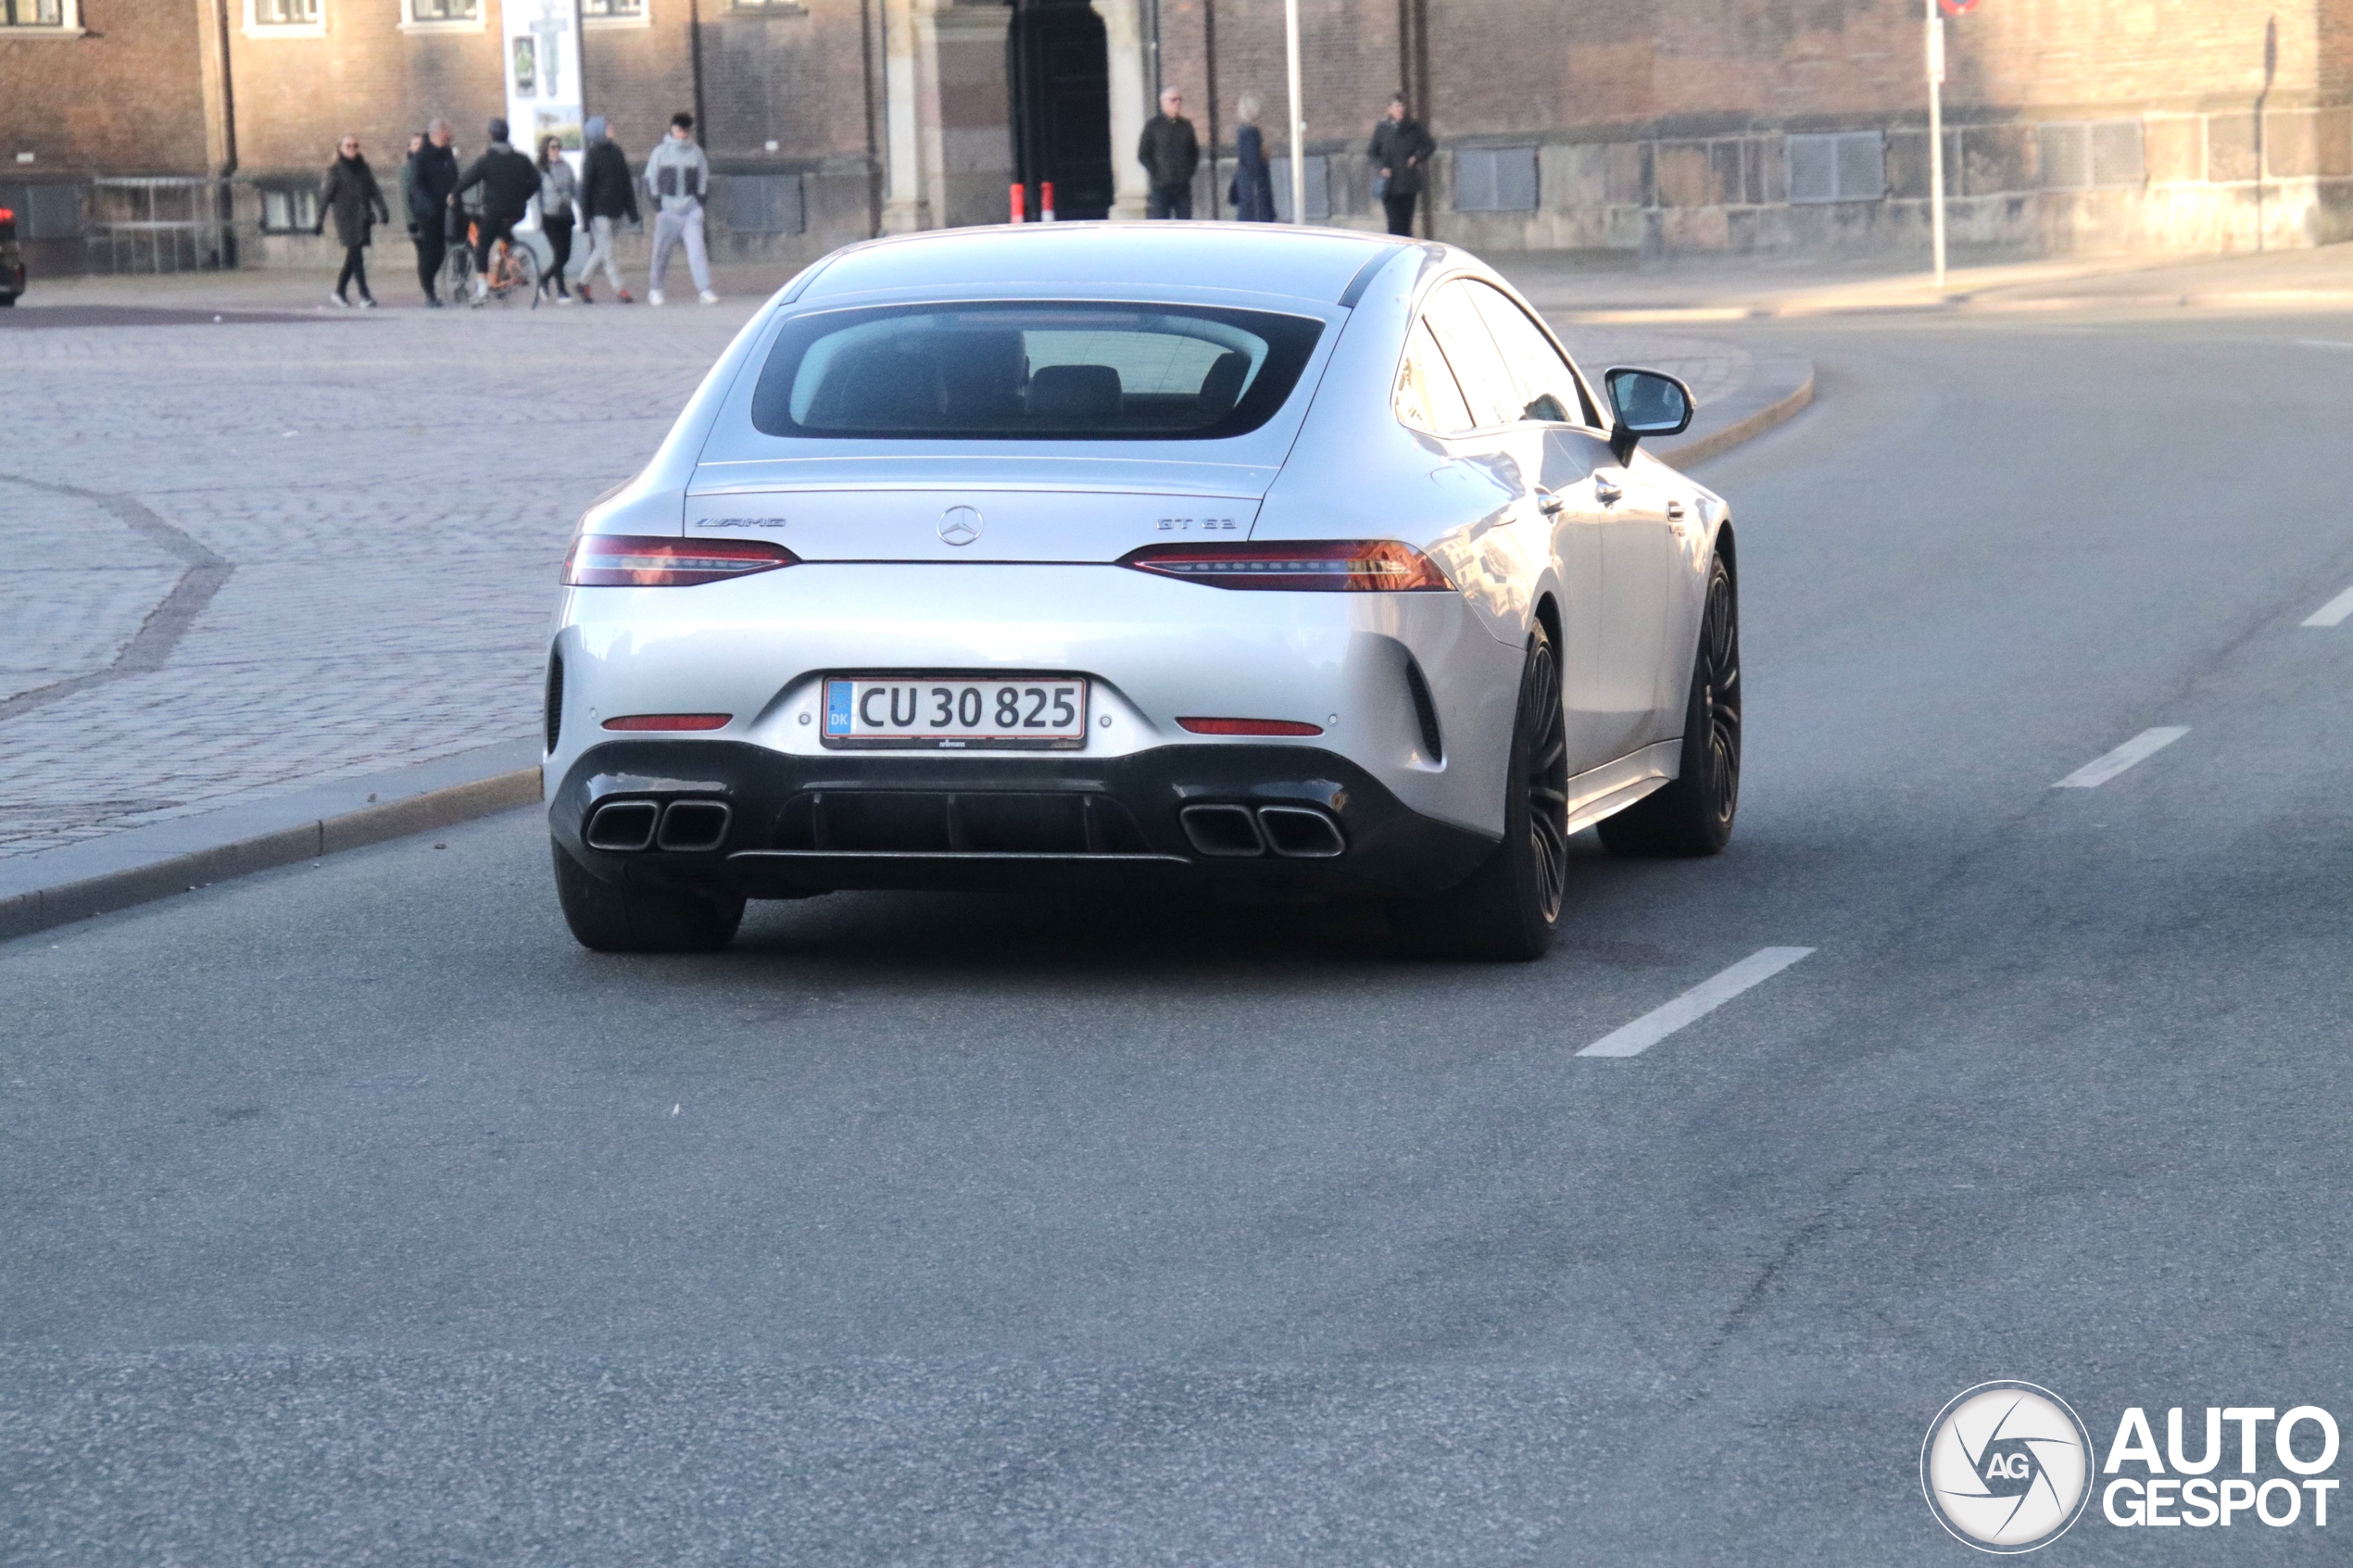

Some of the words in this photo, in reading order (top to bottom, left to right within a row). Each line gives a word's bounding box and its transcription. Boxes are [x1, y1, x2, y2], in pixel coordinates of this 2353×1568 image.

[720, 518, 786, 527] AMG
[1156, 519, 1193, 530] GT
[1202, 519, 1238, 530] 63
[859, 687, 917, 727] CU
[929, 687, 982, 728] 30
[994, 687, 1076, 728] 825
[831, 713, 848, 725] DK
